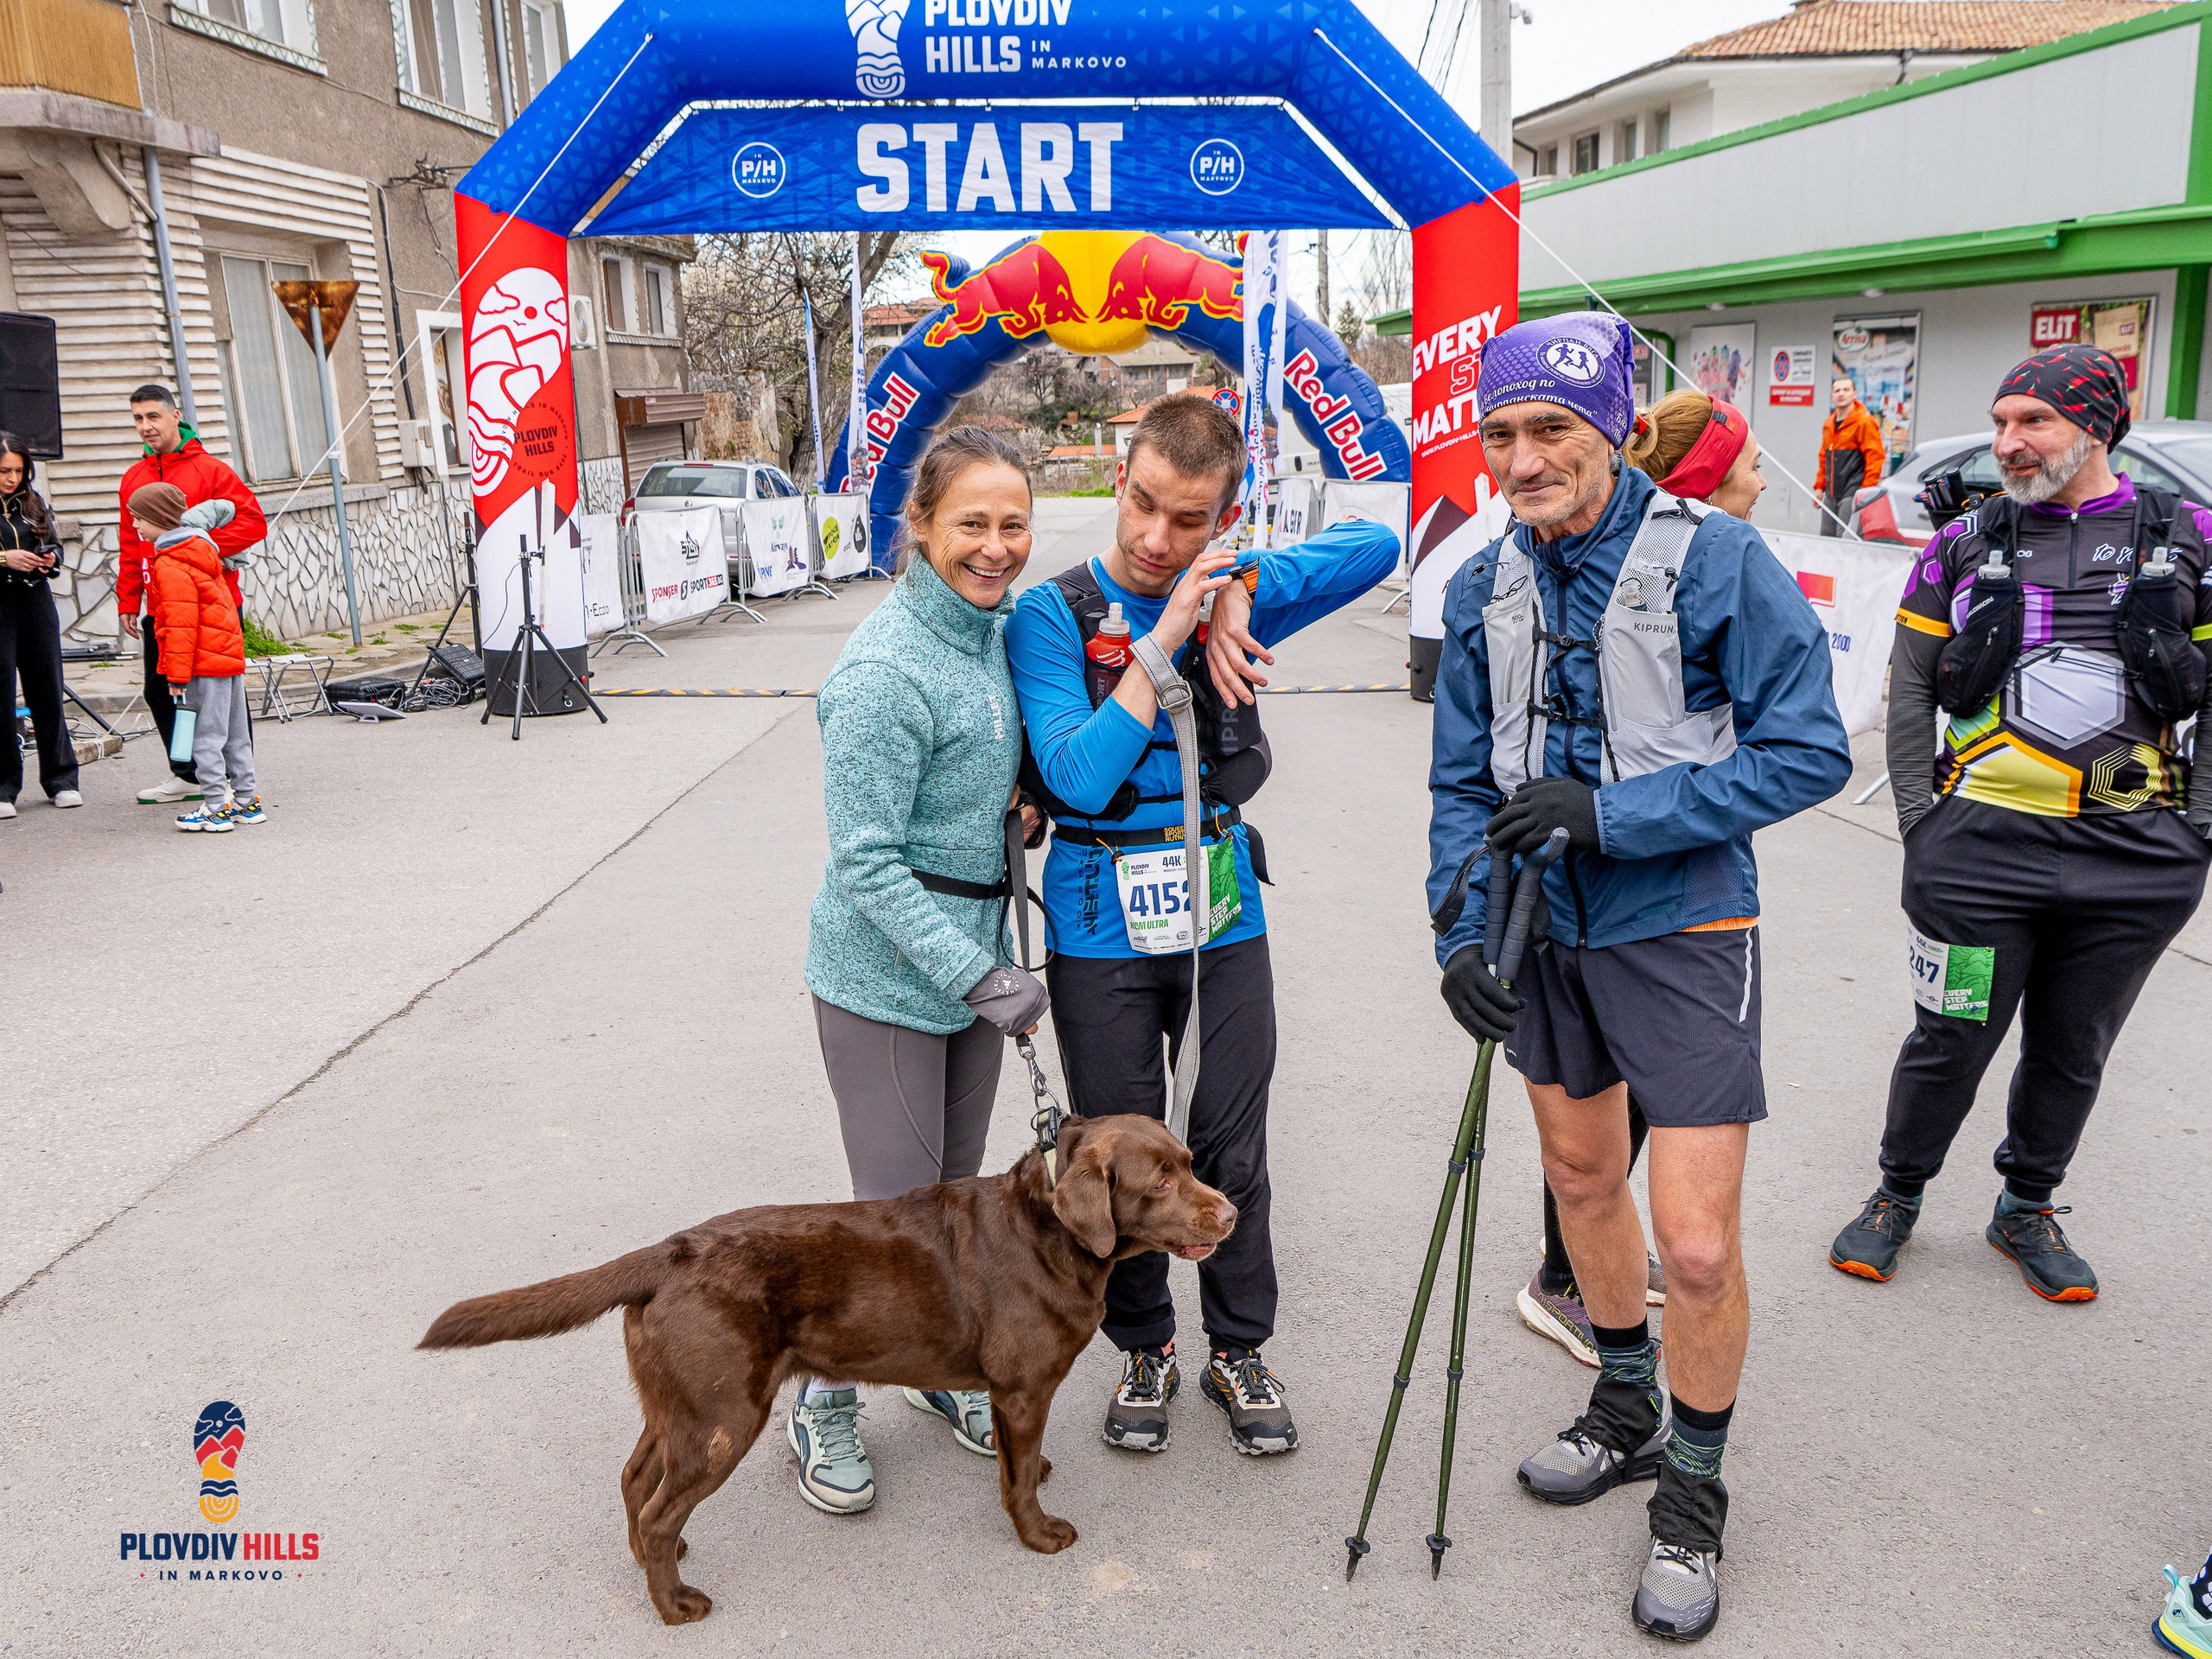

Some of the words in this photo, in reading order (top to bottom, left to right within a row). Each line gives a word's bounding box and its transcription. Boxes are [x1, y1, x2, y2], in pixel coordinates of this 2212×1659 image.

[925, 0, 1071, 26] PLOVDIV
[925, 35, 1021, 73] HILLS
[1032, 40, 1051, 52] IN
[1032, 56, 1127, 68] MARKOVO
[741, 160, 776, 178] P/H
[856, 122, 1123, 212] START
[1199, 156, 1235, 175] P/H
[1413, 305, 1502, 382] EVERY
[1539, 378, 1555, 387] по
[867, 375, 918, 441] Bull
[1284, 352, 1347, 421] Red
[1326, 415, 1383, 480] Bull
[513, 425, 557, 444] PLOVDIV
[524, 441, 555, 457] HILLS
[513, 461, 535, 477] TRAIL
[652, 584, 678, 603] SPONSER
[1633, 621, 1675, 633] KIPRUN
[988, 695, 1003, 740] MILLET
[1162, 855, 1181, 867] 44K
[1129, 880, 1192, 917] 4152
[1147, 918, 1169, 929] ULTRA
[1210, 906, 1228, 924] STEP
